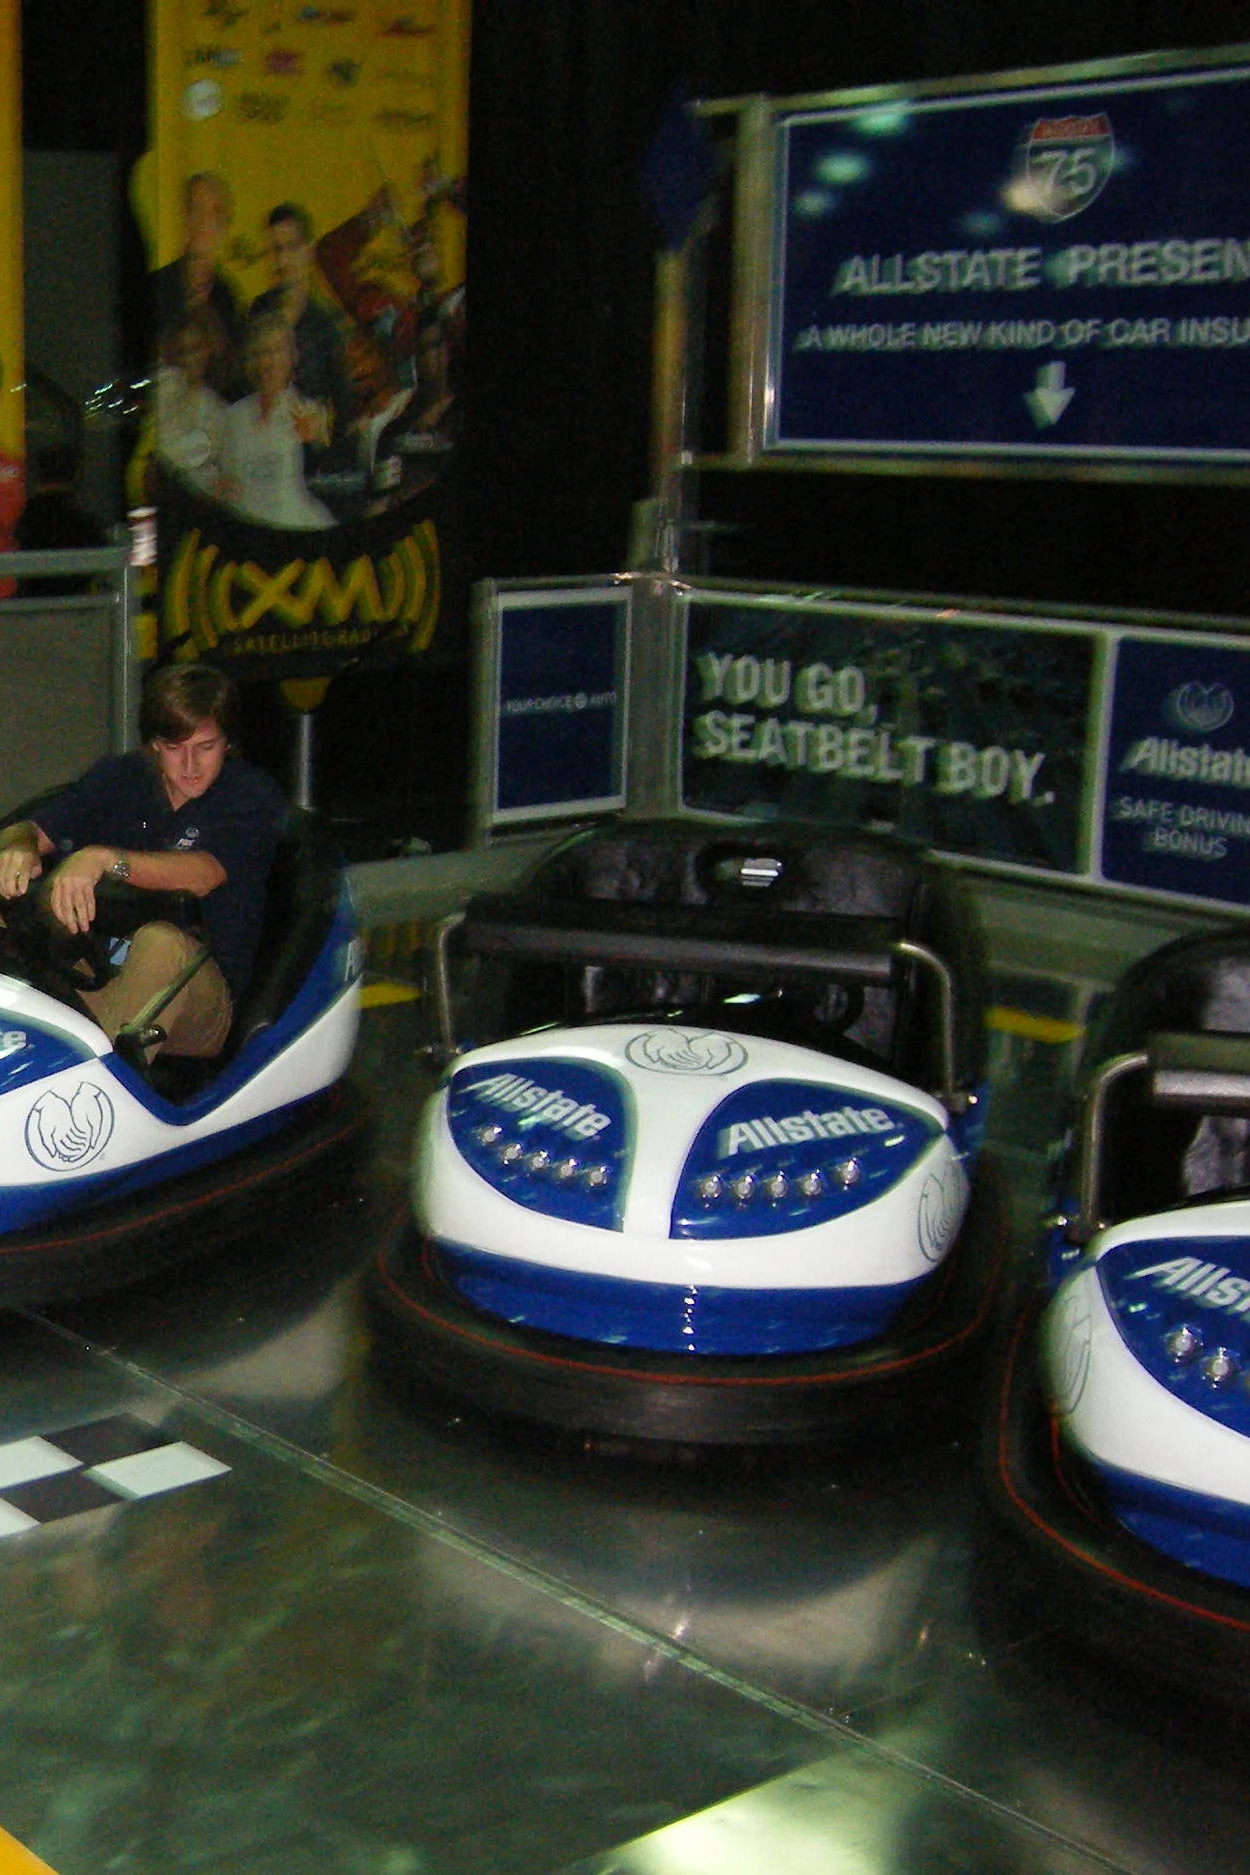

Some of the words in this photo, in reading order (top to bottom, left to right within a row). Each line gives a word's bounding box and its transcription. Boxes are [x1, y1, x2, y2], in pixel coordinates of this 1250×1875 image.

[1032, 148, 1098, 195] 75
[834, 247, 1043, 294] ALLSTATE
[1058, 236, 1250, 287] PRESEN
[797, 324, 824, 349] A
[828, 322, 918, 349] WHOLE
[921, 320, 986, 348] NEW
[988, 318, 1057, 348] KIND
[1060, 317, 1103, 348] OF
[1108, 316, 1172, 346] CAR
[1178, 315, 1250, 346] INSU
[699, 651, 792, 706] YOU
[797, 660, 880, 726] GO,
[696, 710, 937, 785] SEATBELT
[938, 740, 1054, 806] BOY.
[1112, 796, 1174, 825] SAFE
[1148, 828, 1229, 861] BONUS
[455, 1072, 612, 1141] Allstate
[717, 1105, 896, 1159] Allstate
